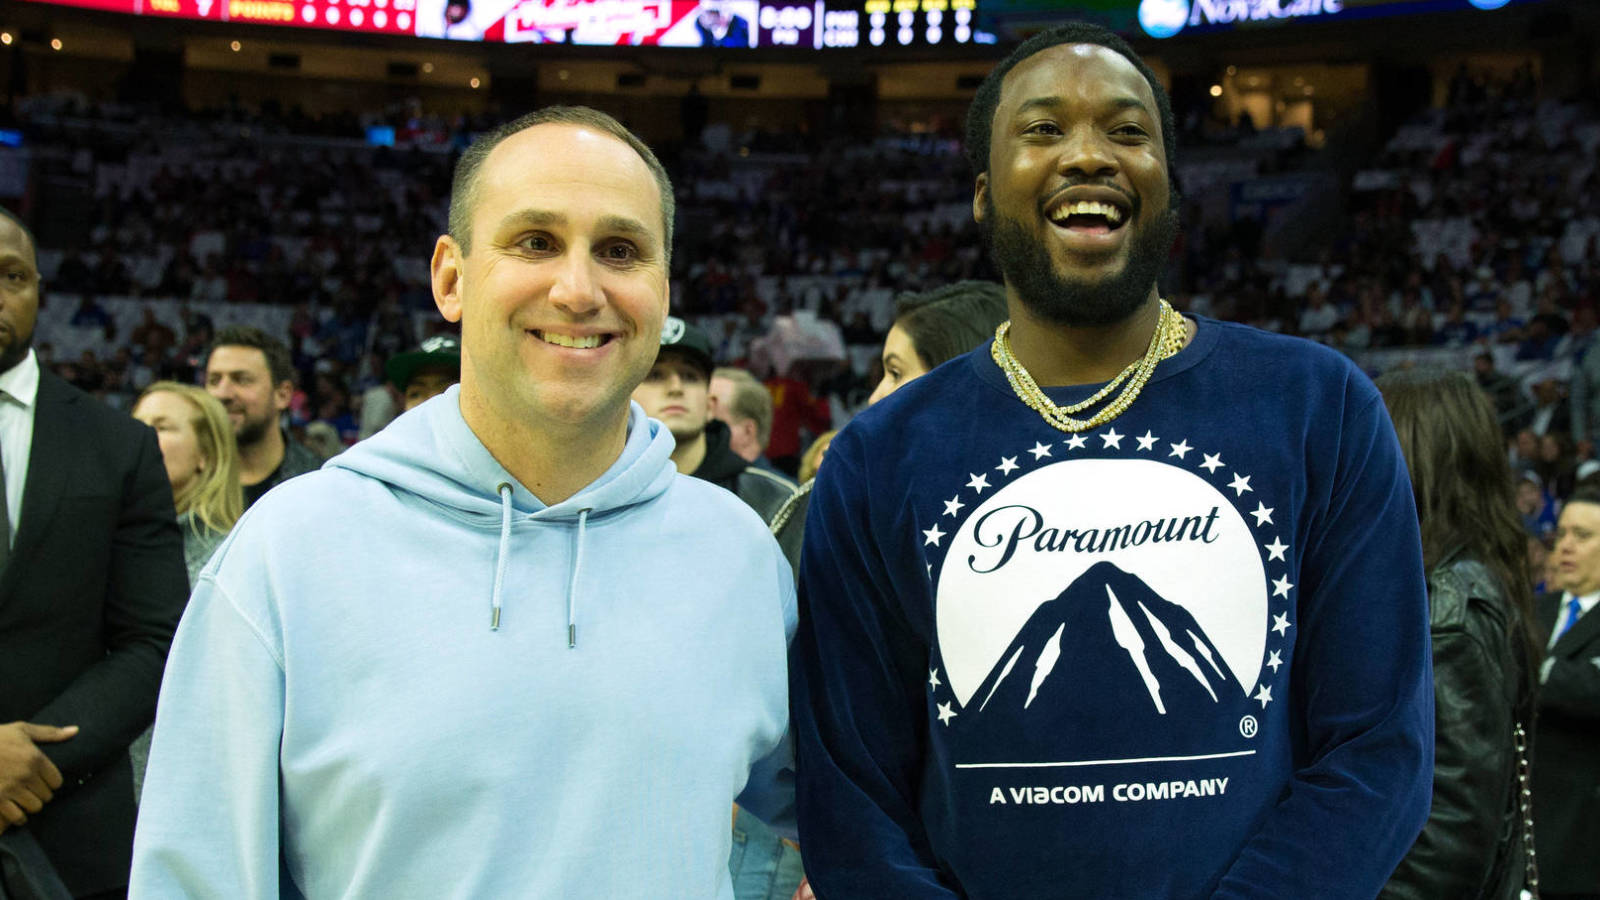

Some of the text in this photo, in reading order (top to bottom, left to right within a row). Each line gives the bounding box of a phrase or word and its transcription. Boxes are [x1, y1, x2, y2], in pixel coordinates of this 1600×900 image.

[967, 505, 1220, 573] Paramount
[989, 787, 1007, 804] A
[1112, 777, 1229, 803] COMPANY
